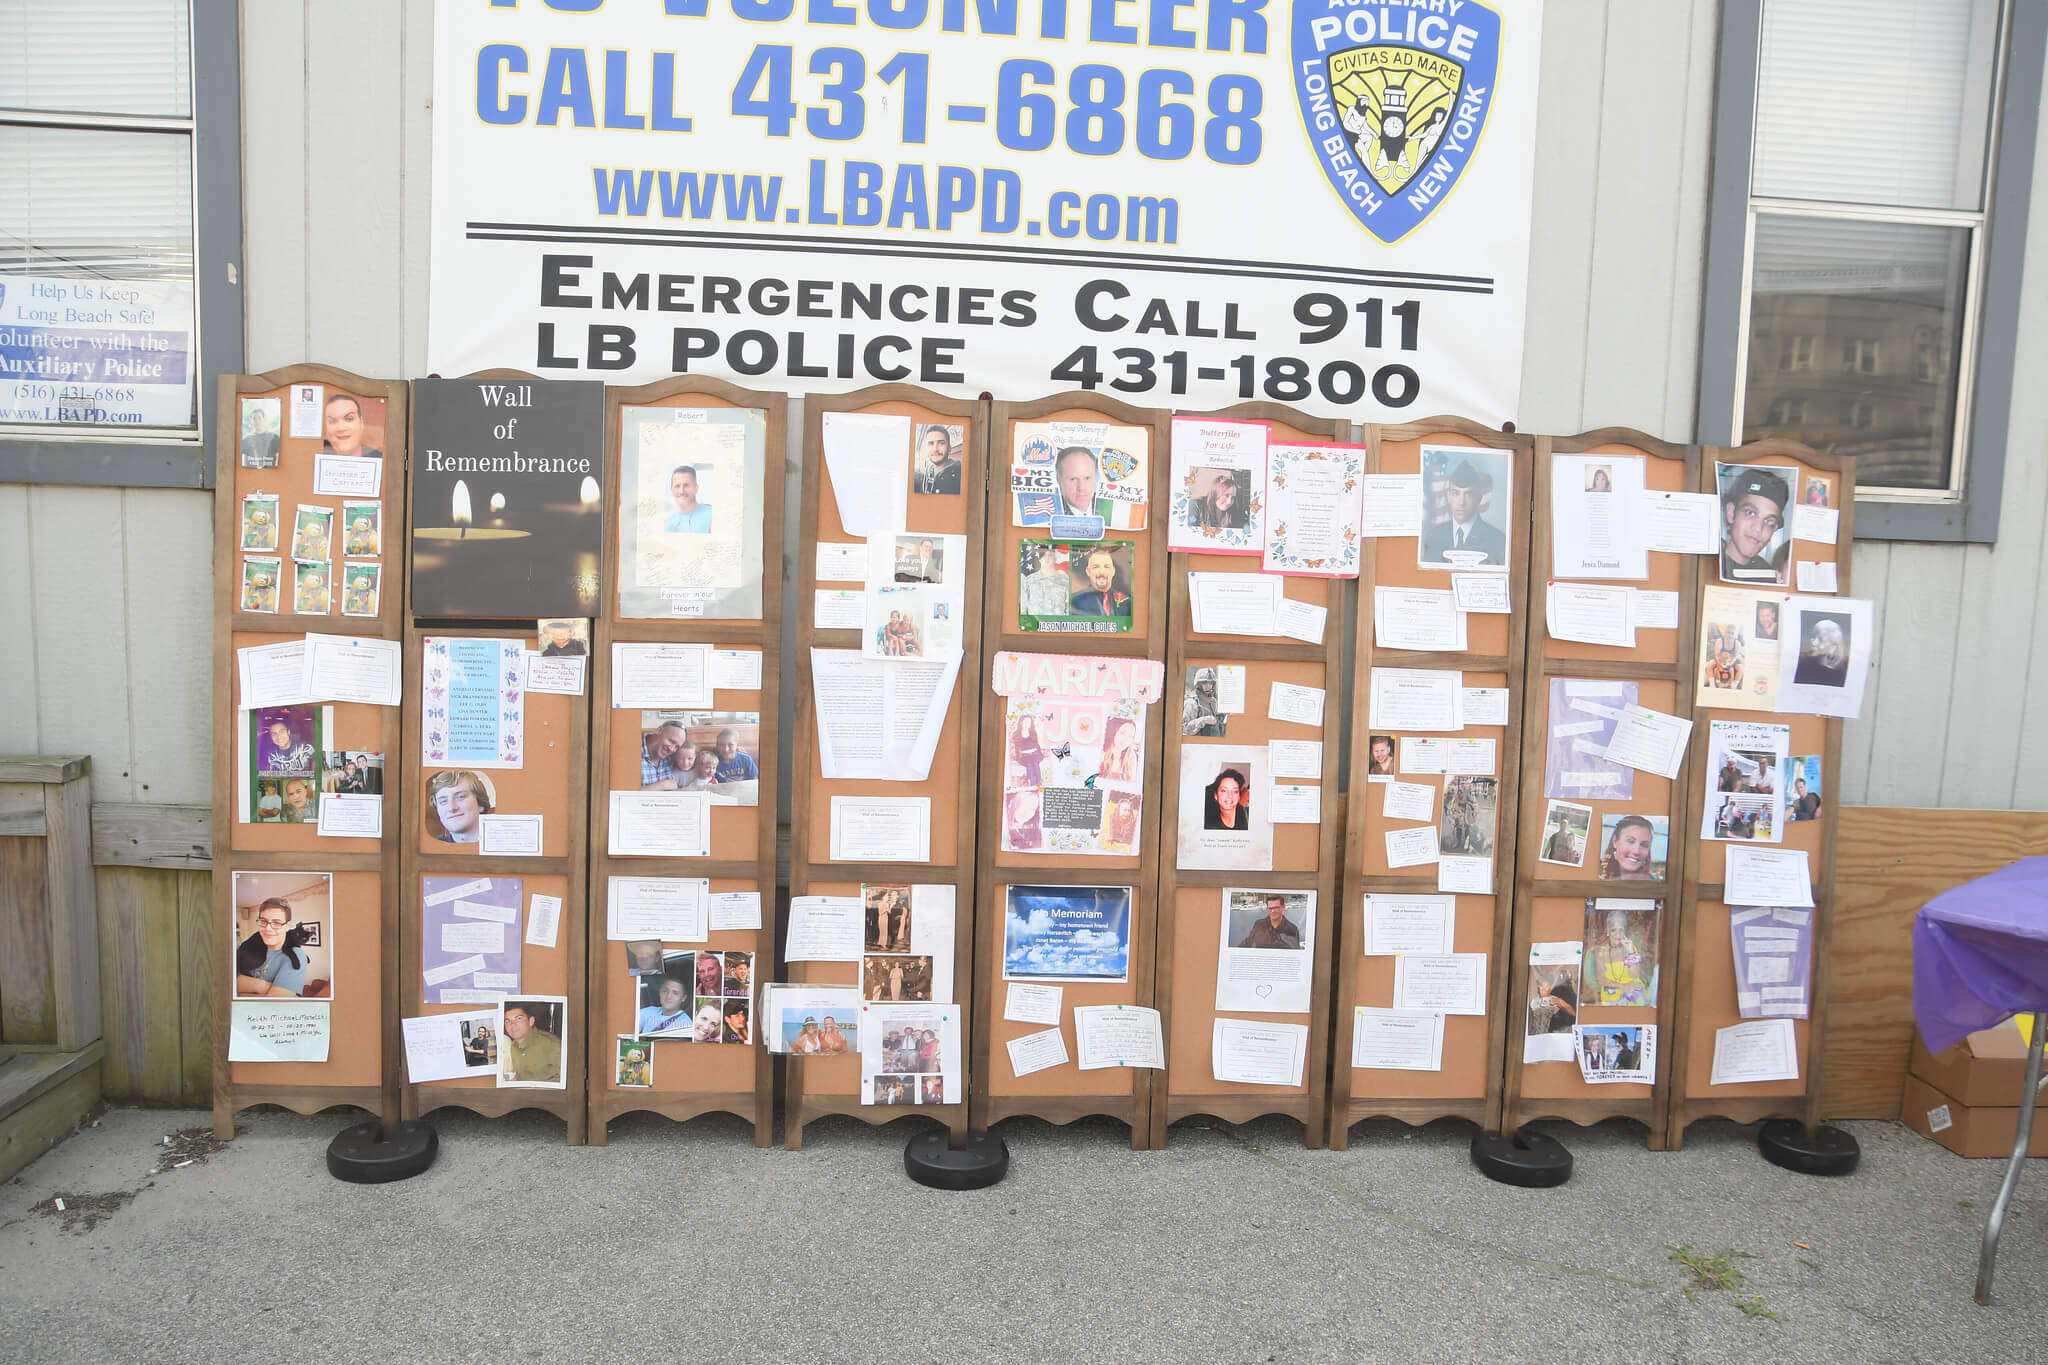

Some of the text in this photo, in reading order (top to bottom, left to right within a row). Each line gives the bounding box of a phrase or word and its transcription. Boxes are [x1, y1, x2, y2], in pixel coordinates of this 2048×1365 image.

[1311, 8, 1479, 61] POLICE
[1334, 51, 1458, 82] CIVITAS AD MARE
[475, 42, 1265, 166] CALL 431-6868
[1302, 58, 1383, 215] LONG BEACH
[1407, 83, 1486, 212] NEW YORK
[591, 157, 1180, 245] www.LBAPD.com
[31, 283, 139, 304] Help Us Keep
[17, 306, 155, 325] Long Beach Safe!
[1074, 279, 1257, 341] CALL
[1293, 292, 1421, 351] 911
[0, 327, 169, 352] olunteer with the
[104, 357, 163, 377] Police
[536, 322, 1420, 408] LB POLICE 431-1800
[14, 385, 135, 401] (516) 431-6868
[478, 385, 533, 407] Wall
[493, 419, 518, 440] of
[425, 450, 591, 473] Remembrance
[1011, 475, 1054, 487] BIG
[1120, 486, 1145, 496] MY
[998, 656, 1160, 699] MARIAH
[1046, 707, 1100, 745] JO
[1050, 908, 1103, 919] Memoriam
